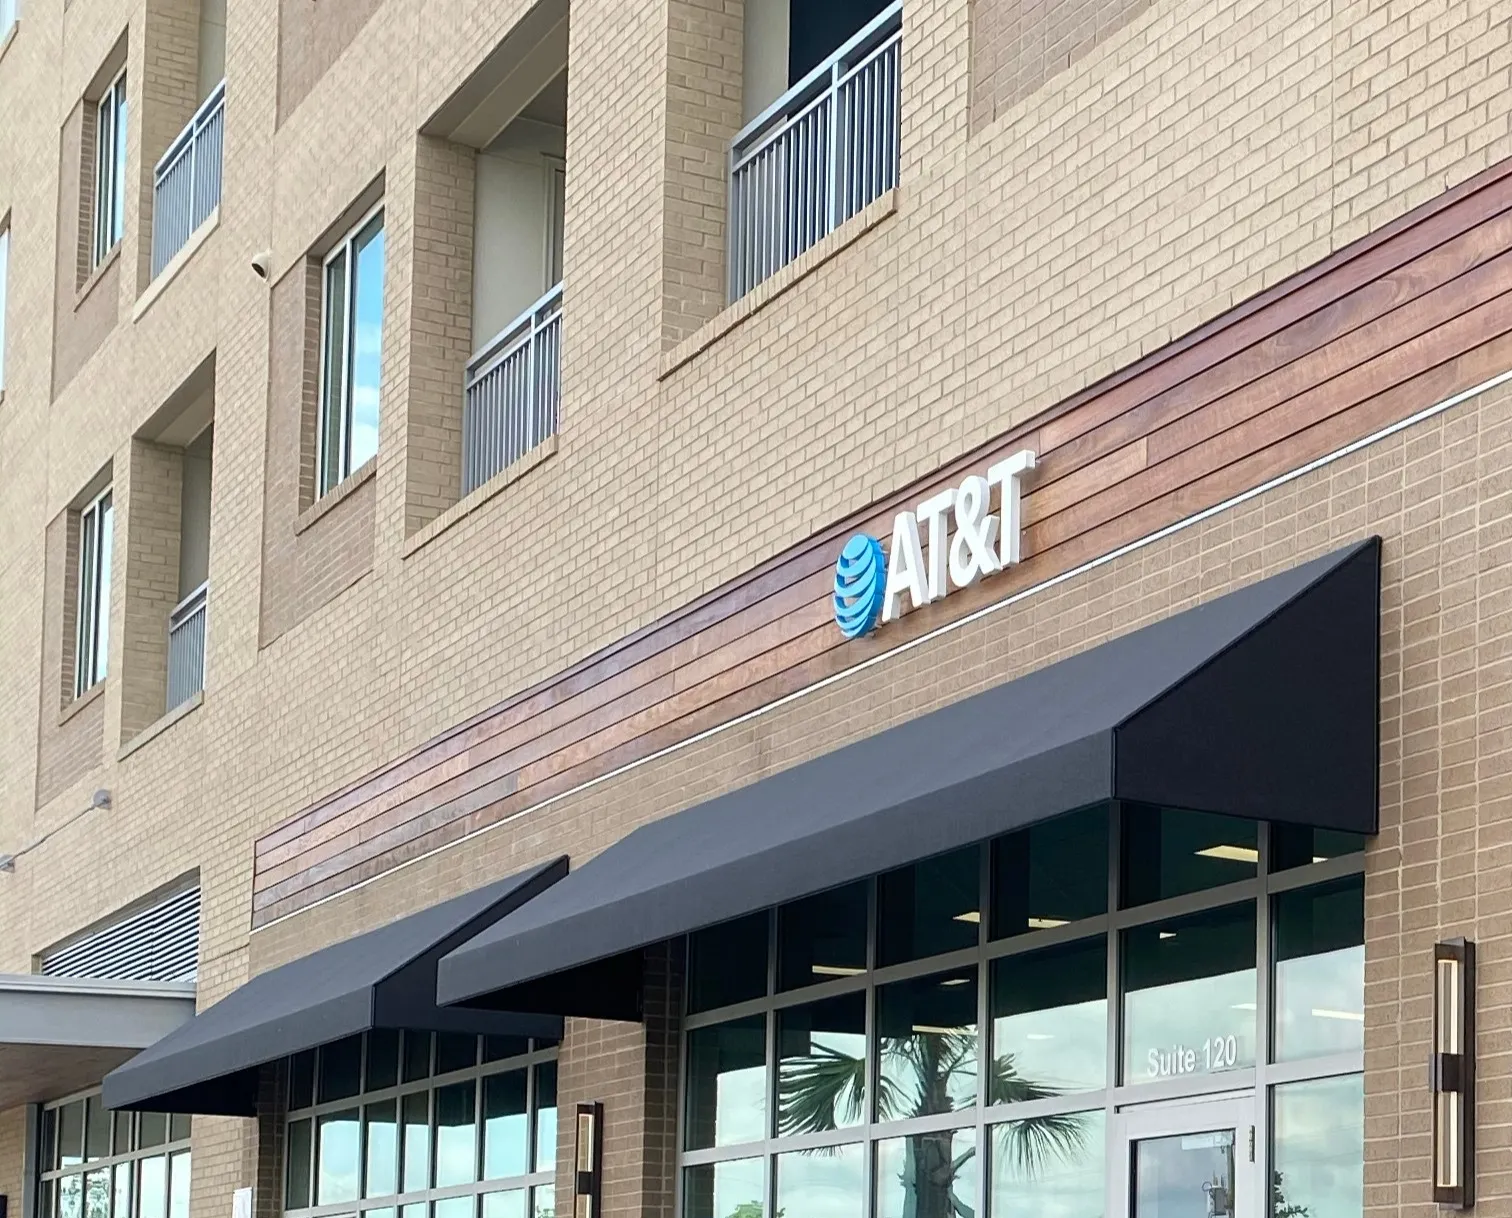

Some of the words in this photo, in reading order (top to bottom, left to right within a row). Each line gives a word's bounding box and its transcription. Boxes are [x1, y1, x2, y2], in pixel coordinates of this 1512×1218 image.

[882, 449, 1036, 623] AT&T
[1147, 1044, 1196, 1077] Suite
[1203, 1034, 1237, 1069] 120
